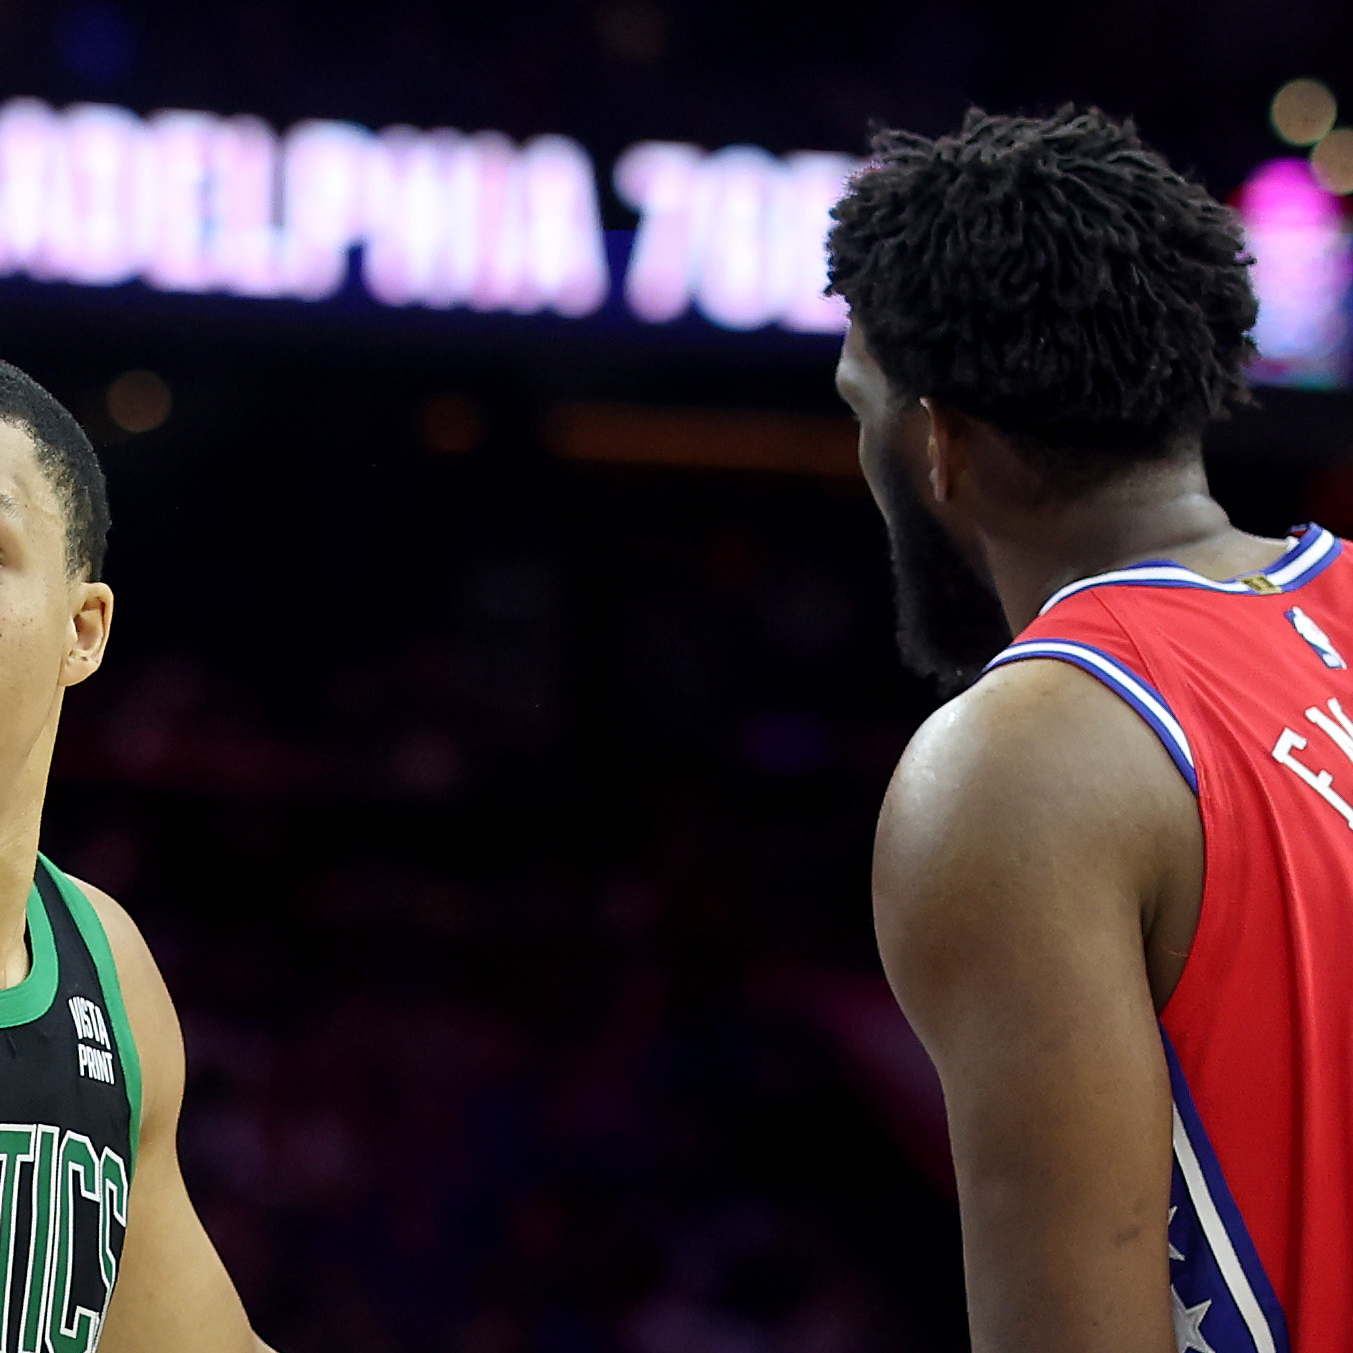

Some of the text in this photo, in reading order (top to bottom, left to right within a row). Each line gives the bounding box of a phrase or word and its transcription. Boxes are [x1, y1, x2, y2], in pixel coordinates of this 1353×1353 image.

[613, 138, 862, 334] 76E
[68, 996, 111, 1051] VISTA
[77, 1043, 115, 1085] PRINT
